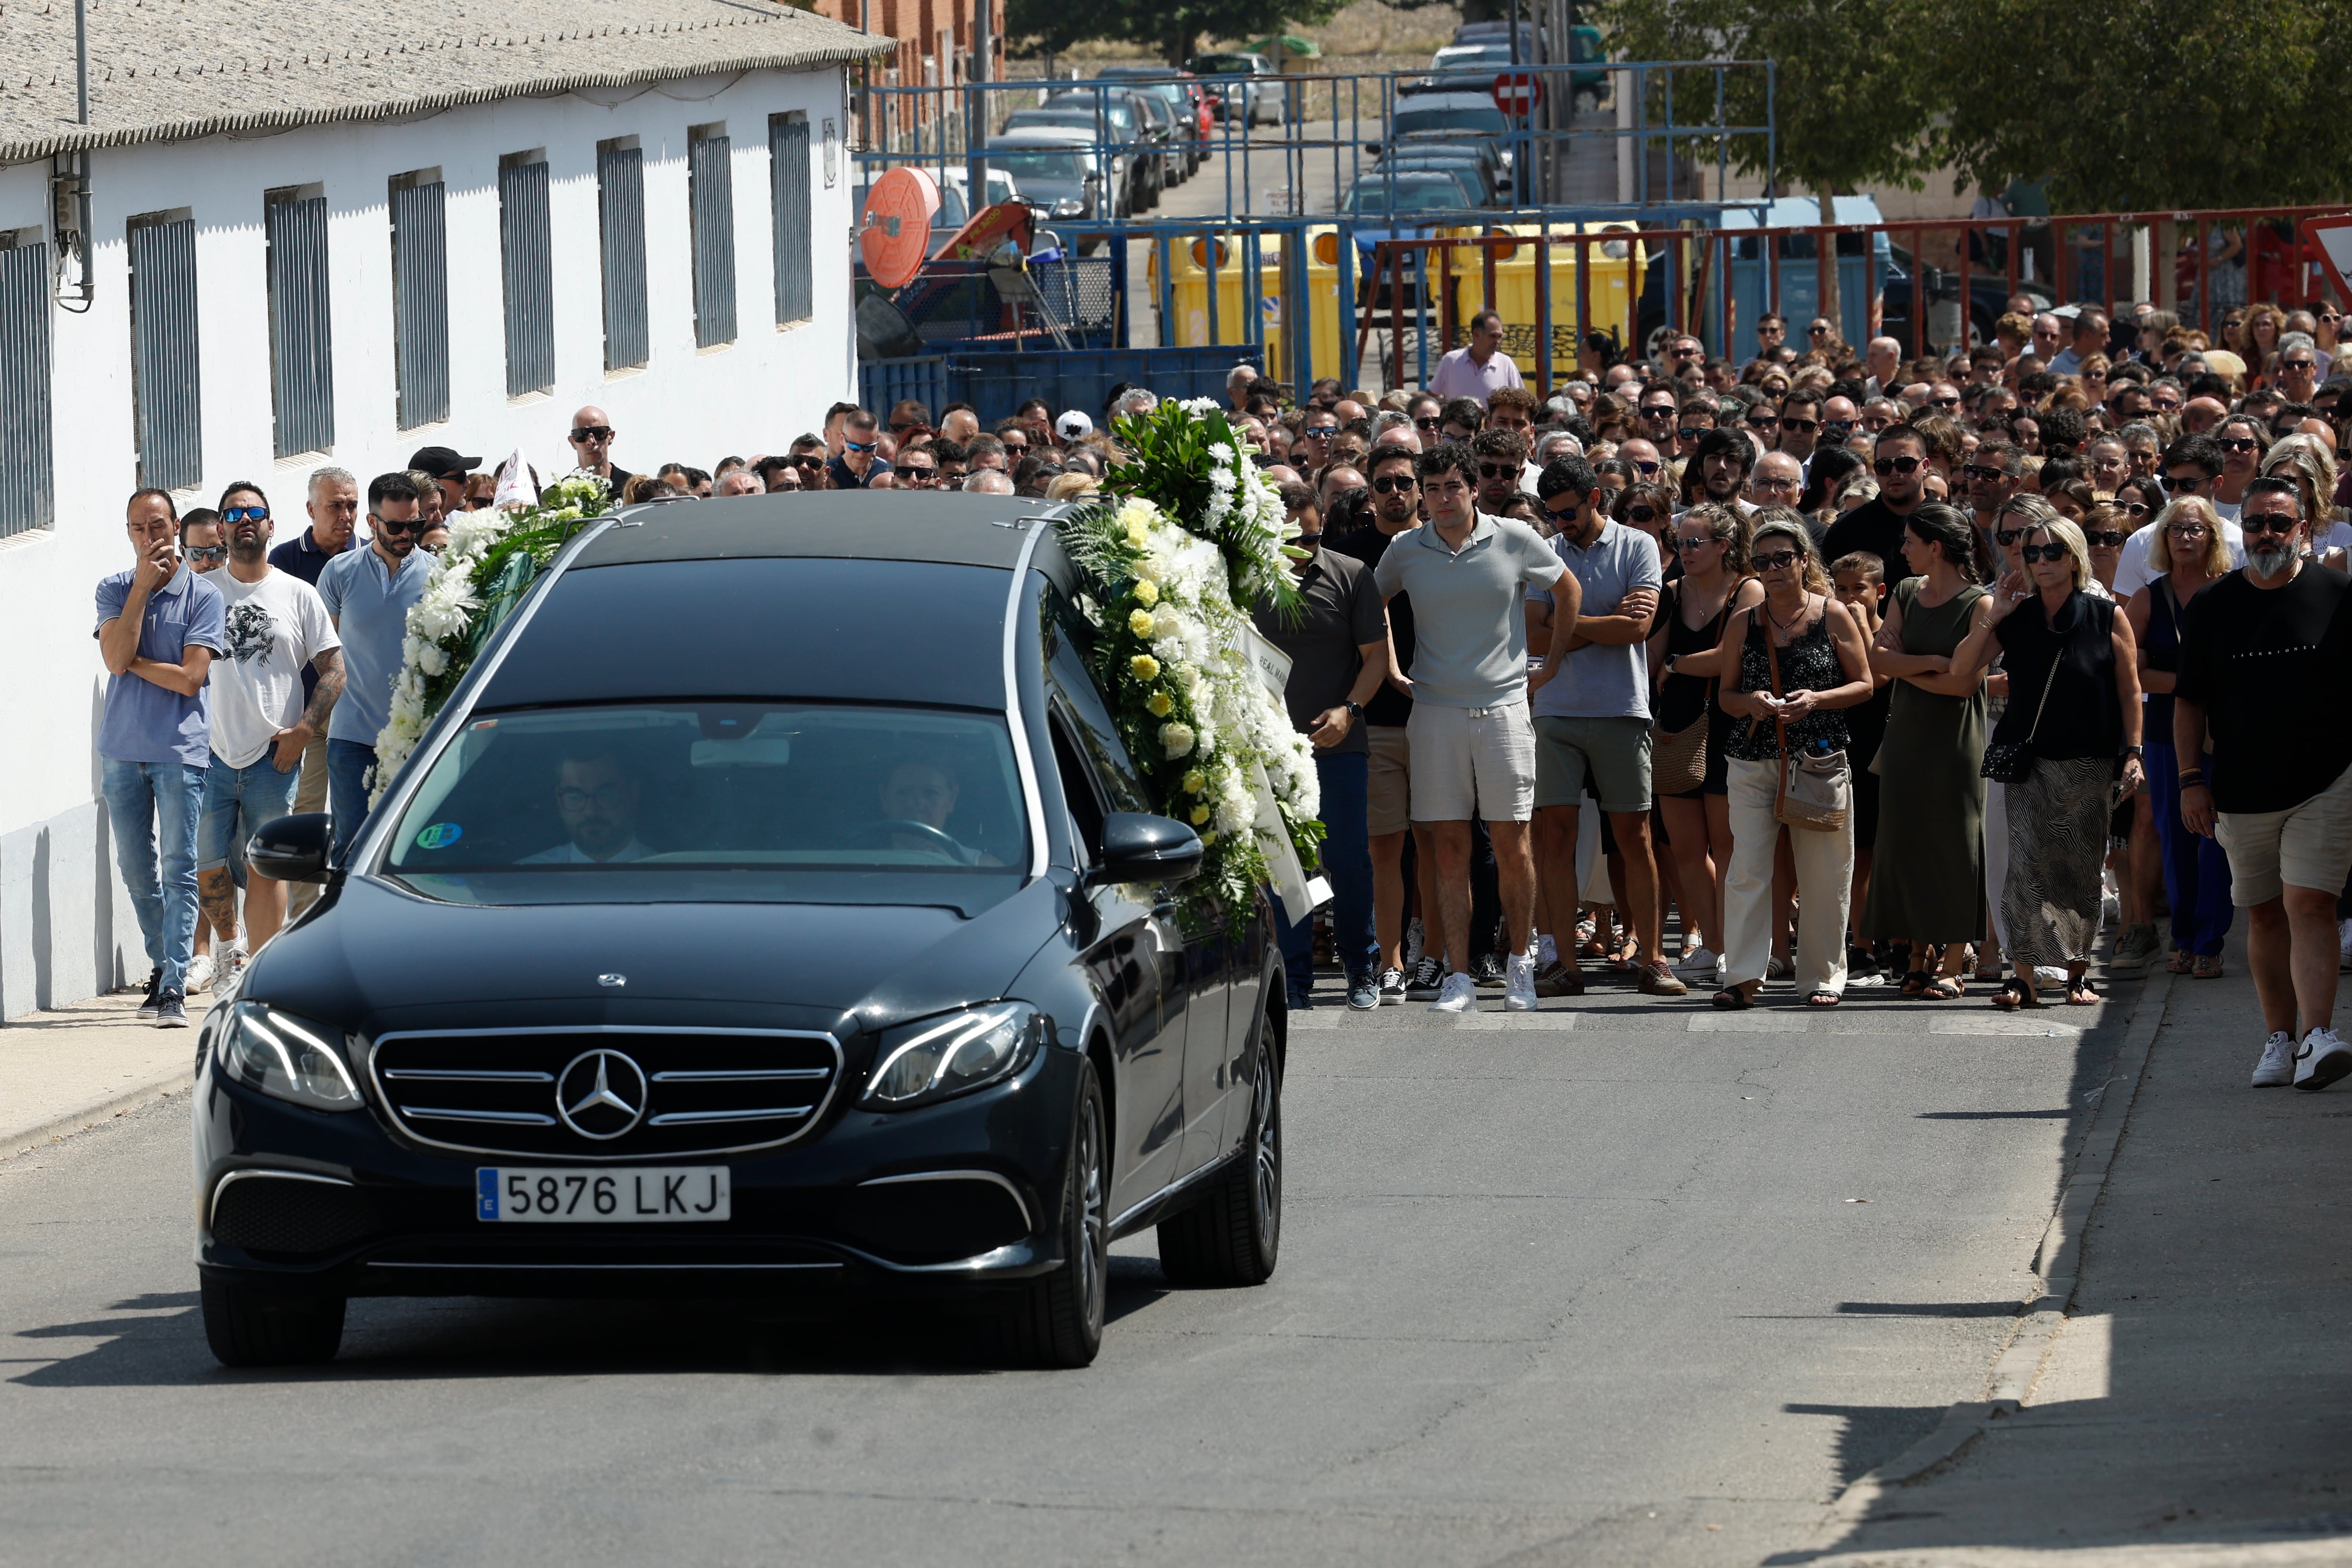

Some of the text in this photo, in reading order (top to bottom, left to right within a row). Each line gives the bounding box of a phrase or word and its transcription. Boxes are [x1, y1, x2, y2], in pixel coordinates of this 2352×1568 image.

[1259, 656, 1274, 675] REAL
[508, 1175, 717, 1215] 5876 LKJ
[484, 1200, 493, 1211] E
